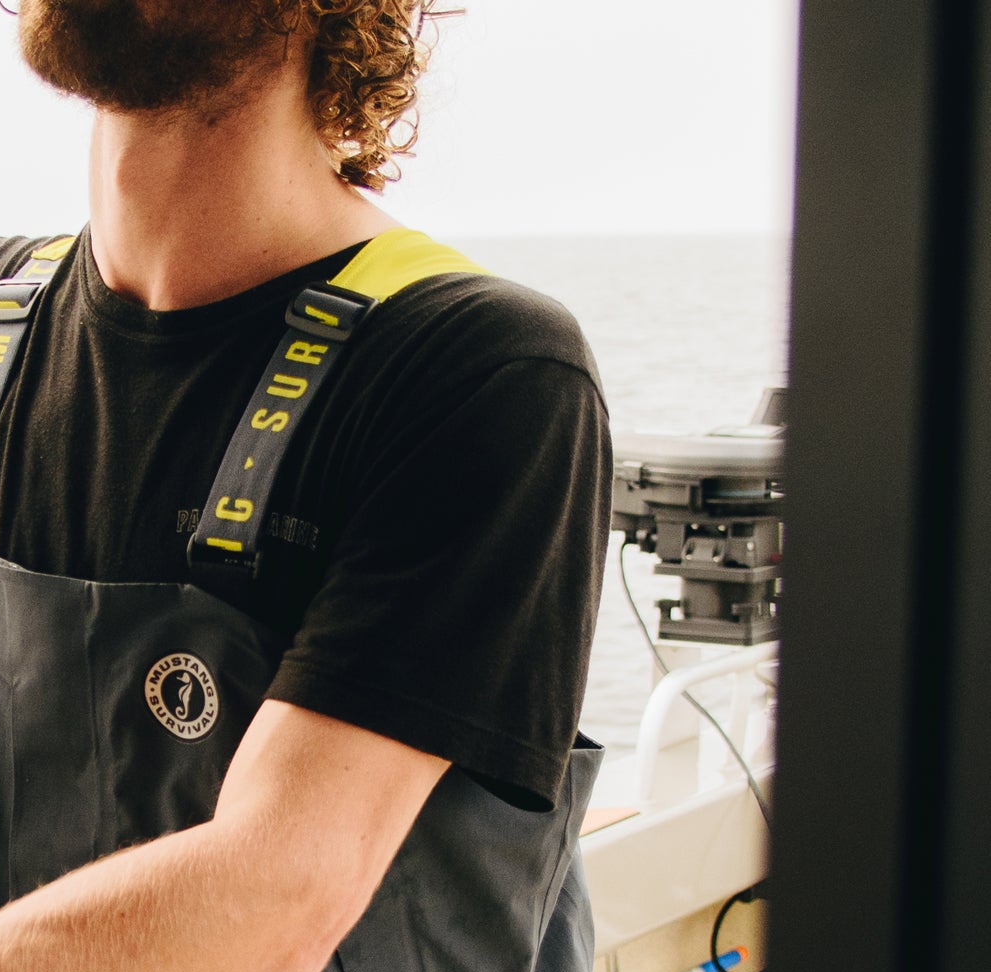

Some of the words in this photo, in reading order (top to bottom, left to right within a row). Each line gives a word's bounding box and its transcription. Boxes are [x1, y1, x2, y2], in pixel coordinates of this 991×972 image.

[176, 509, 202, 533] PA
[149, 656, 214, 698] MUSTANG
[149, 695, 215, 735] SURVIVAL
